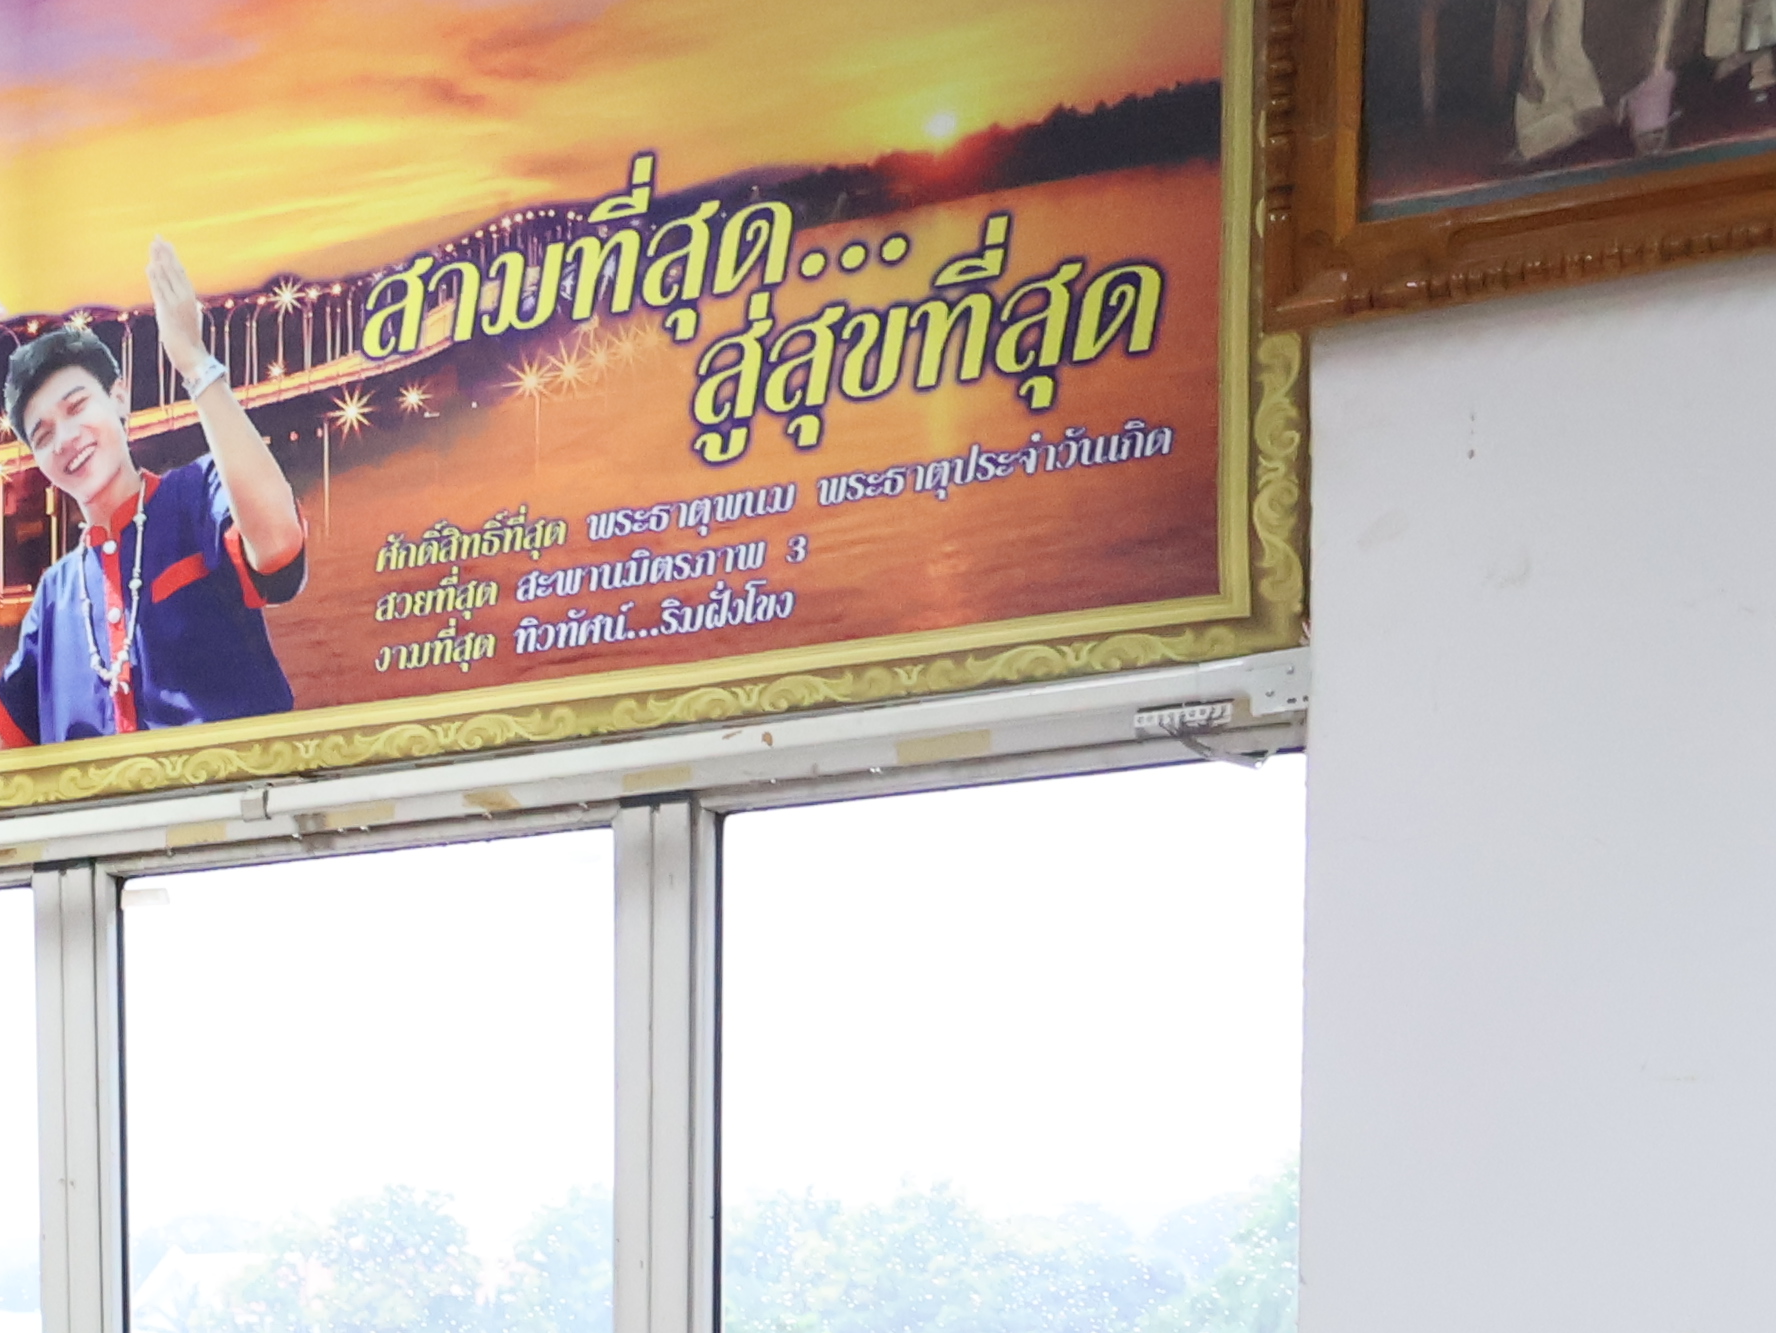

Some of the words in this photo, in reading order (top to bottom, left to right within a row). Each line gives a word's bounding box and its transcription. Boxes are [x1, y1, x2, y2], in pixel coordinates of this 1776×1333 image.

[362, 155, 909, 360] สามที่สุด...
[694, 215, 1162, 464] สู่สุขที่สุด
[587, 482, 796, 538] พระธาตุพนม
[817, 421, 1172, 511] พระธาตุประจำวันเกิด
[374, 568, 499, 624] สวยที่สุด
[515, 538, 766, 603] สะพานมิตรภาพ
[785, 536, 808, 564] 3
[374, 617, 496, 672] งามที่สุด
